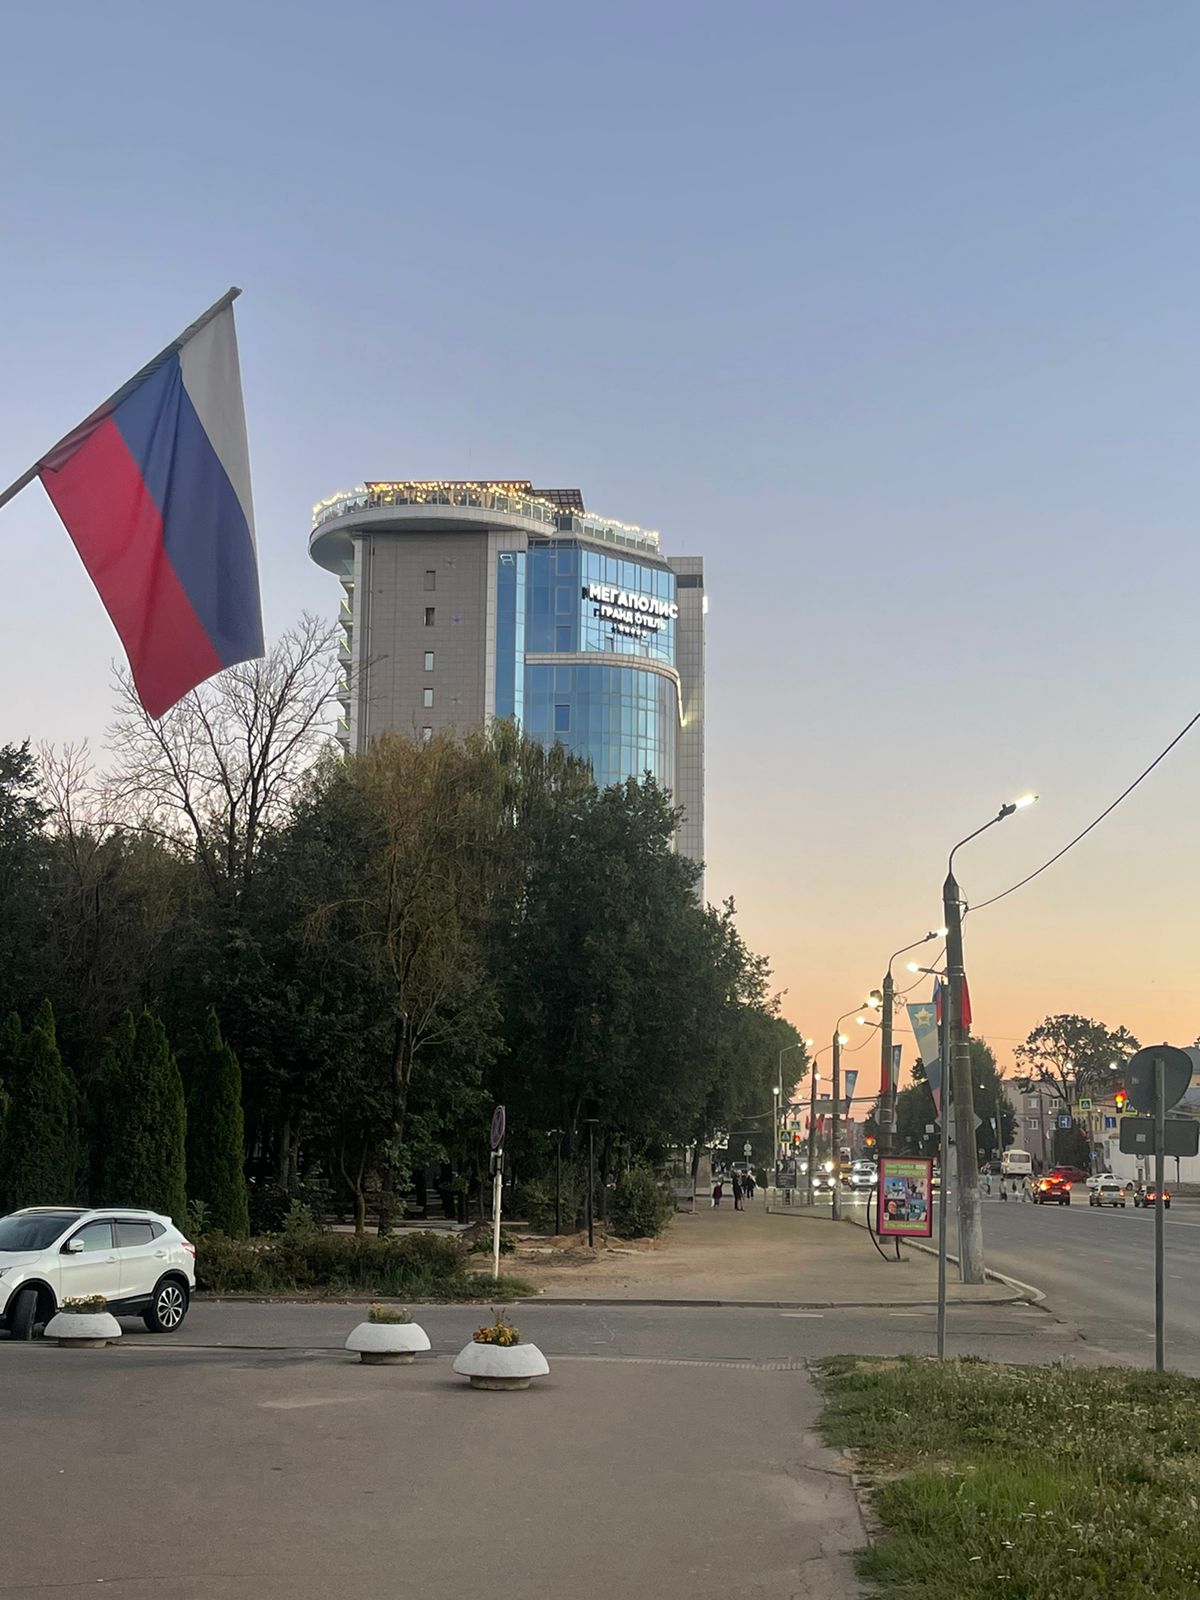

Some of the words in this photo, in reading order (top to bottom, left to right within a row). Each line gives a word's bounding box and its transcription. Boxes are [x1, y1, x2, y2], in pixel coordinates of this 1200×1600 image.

[589, 584, 679, 618] МЕГАПОЛИС
[601, 605, 633, 623] ГРАНД
[635, 613, 667, 630] ОТЕЛЬ
